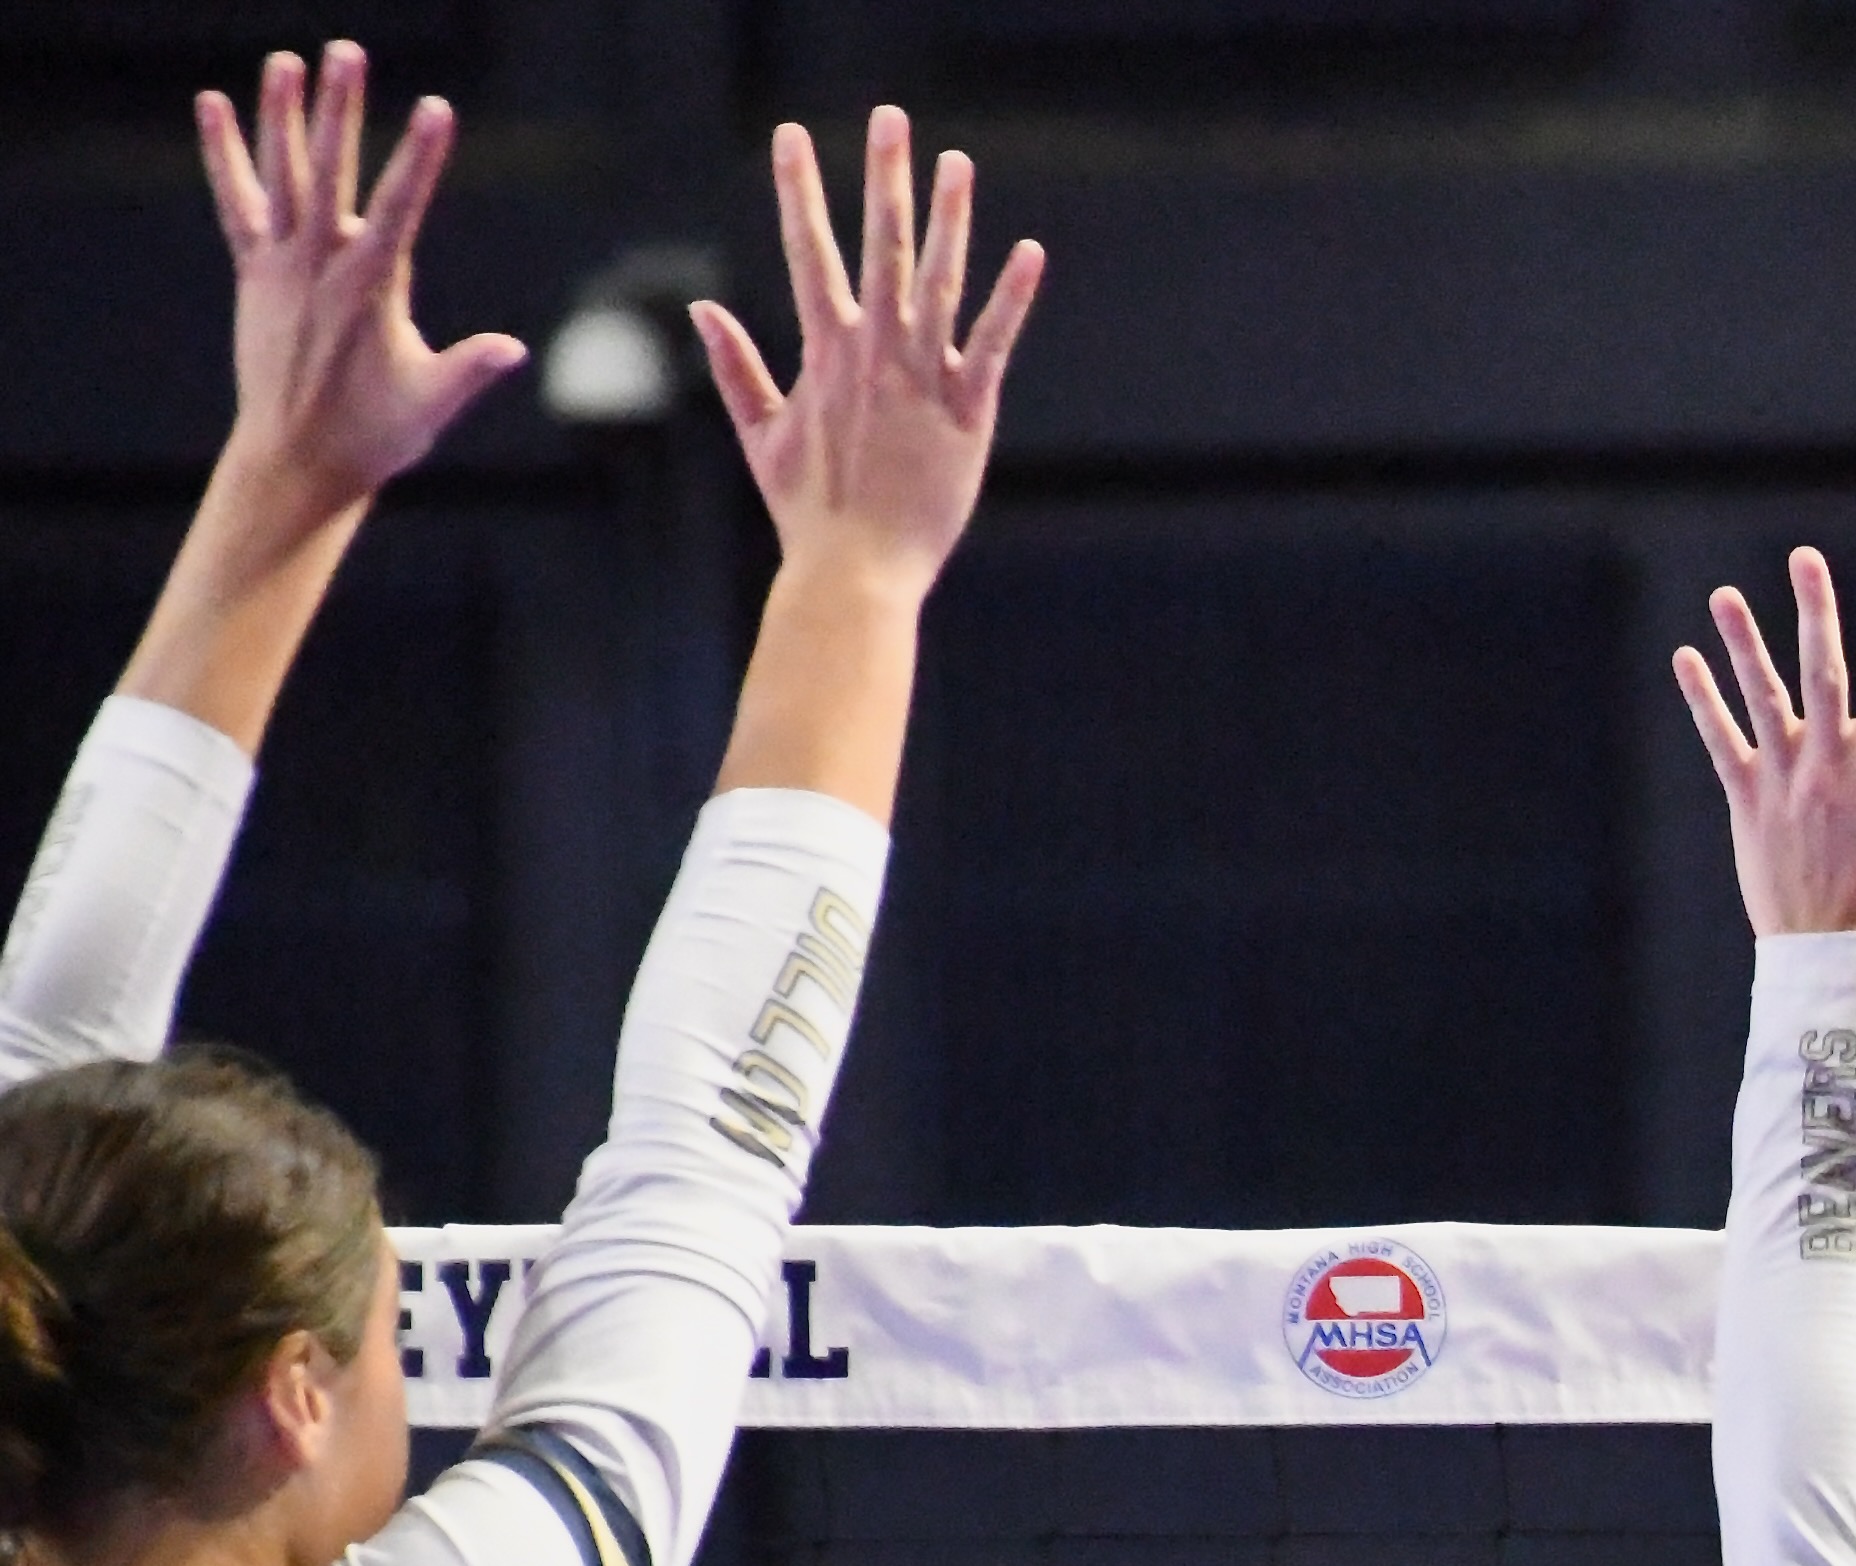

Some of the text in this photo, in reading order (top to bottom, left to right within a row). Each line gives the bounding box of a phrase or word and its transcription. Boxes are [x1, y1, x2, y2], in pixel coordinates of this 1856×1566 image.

[1287, 1241, 1441, 1324] MONTANA HIGH SCHOOL
[1299, 1321, 1432, 1371] MHSA
[1309, 1361, 1419, 1396] ASSOCIATION
